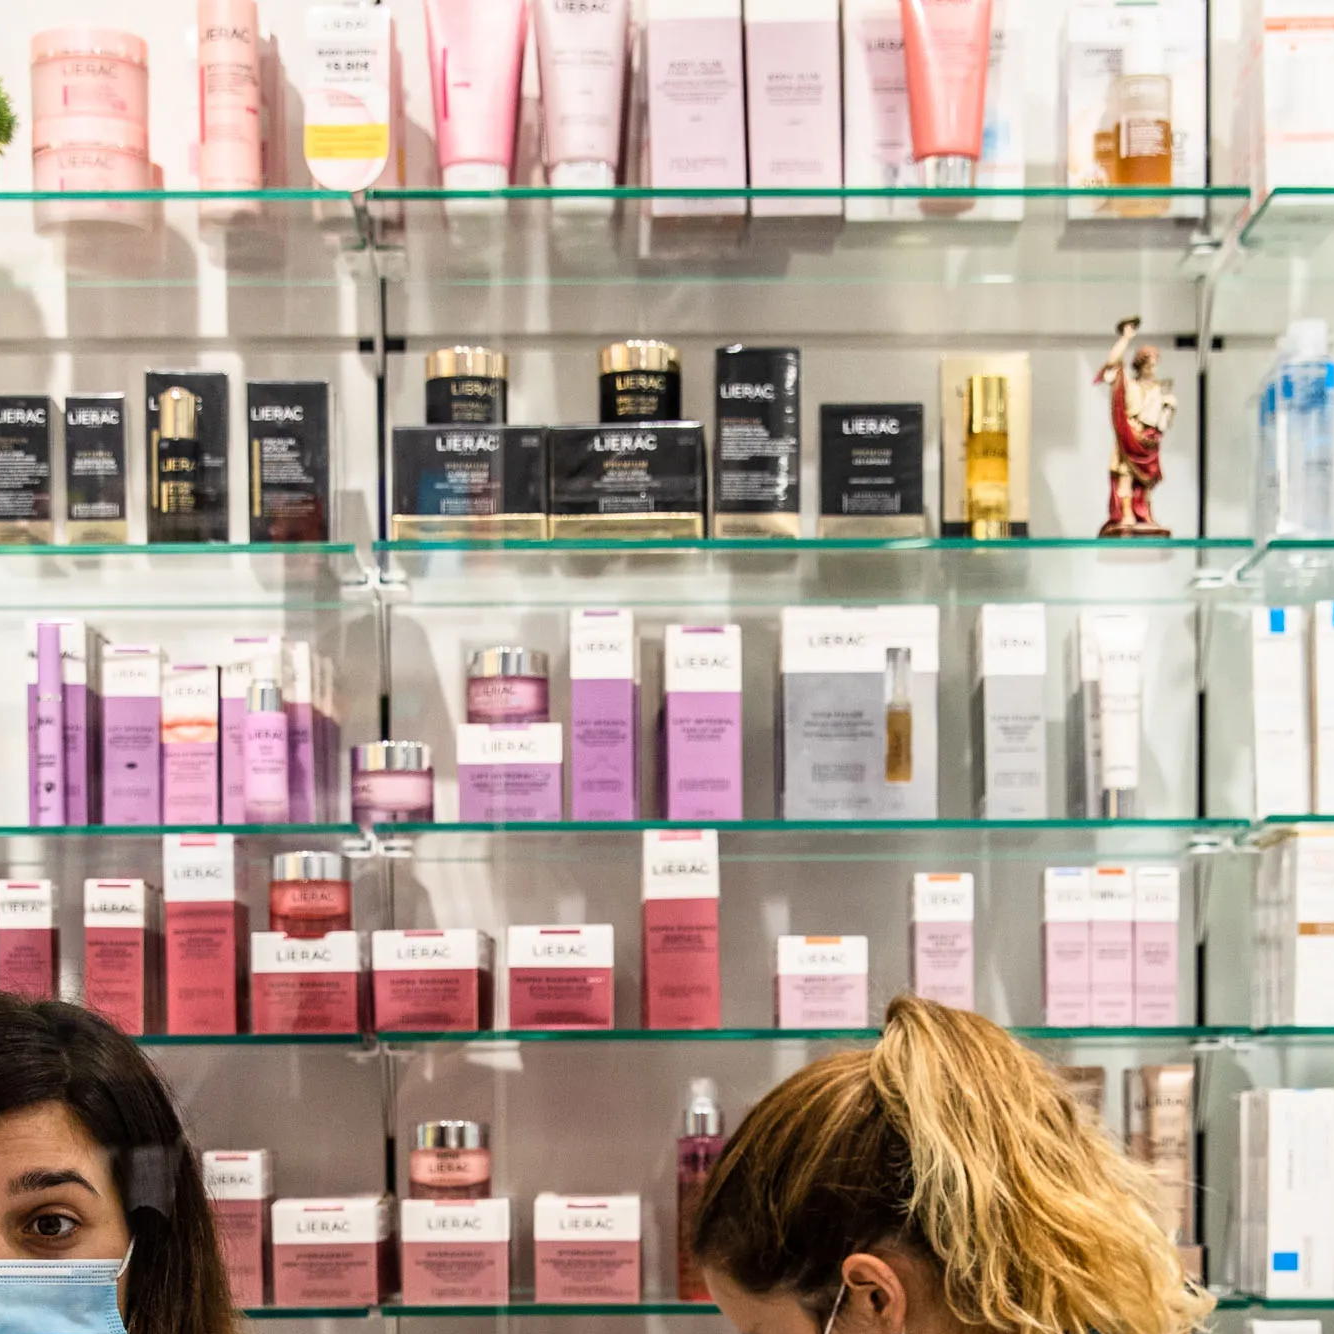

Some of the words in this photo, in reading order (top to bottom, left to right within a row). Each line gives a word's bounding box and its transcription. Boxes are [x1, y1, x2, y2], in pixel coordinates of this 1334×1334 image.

[451, 381, 498, 397] LIERAC
[616, 375, 666, 391] LIERAC
[720, 383, 775, 400] LIERAC
[67, 411, 120, 426] LIERAC
[250, 406, 304, 422] LIERAC
[842, 419, 900, 436] LIERAC
[435, 435, 500, 451] LIERAC
[593, 434, 658, 451] LIERAC
[173, 867, 222, 880] LIERAC
[651, 863, 710, 877] LIERAC
[276, 949, 333, 963] LIERAC
[396, 946, 451, 960] LIERAC
[532, 944, 588, 958] LIERAC
[296, 1221, 350, 1235] LIERAC
[426, 1217, 482, 1232] LIERAC
[559, 1217, 614, 1232] LIERAC
